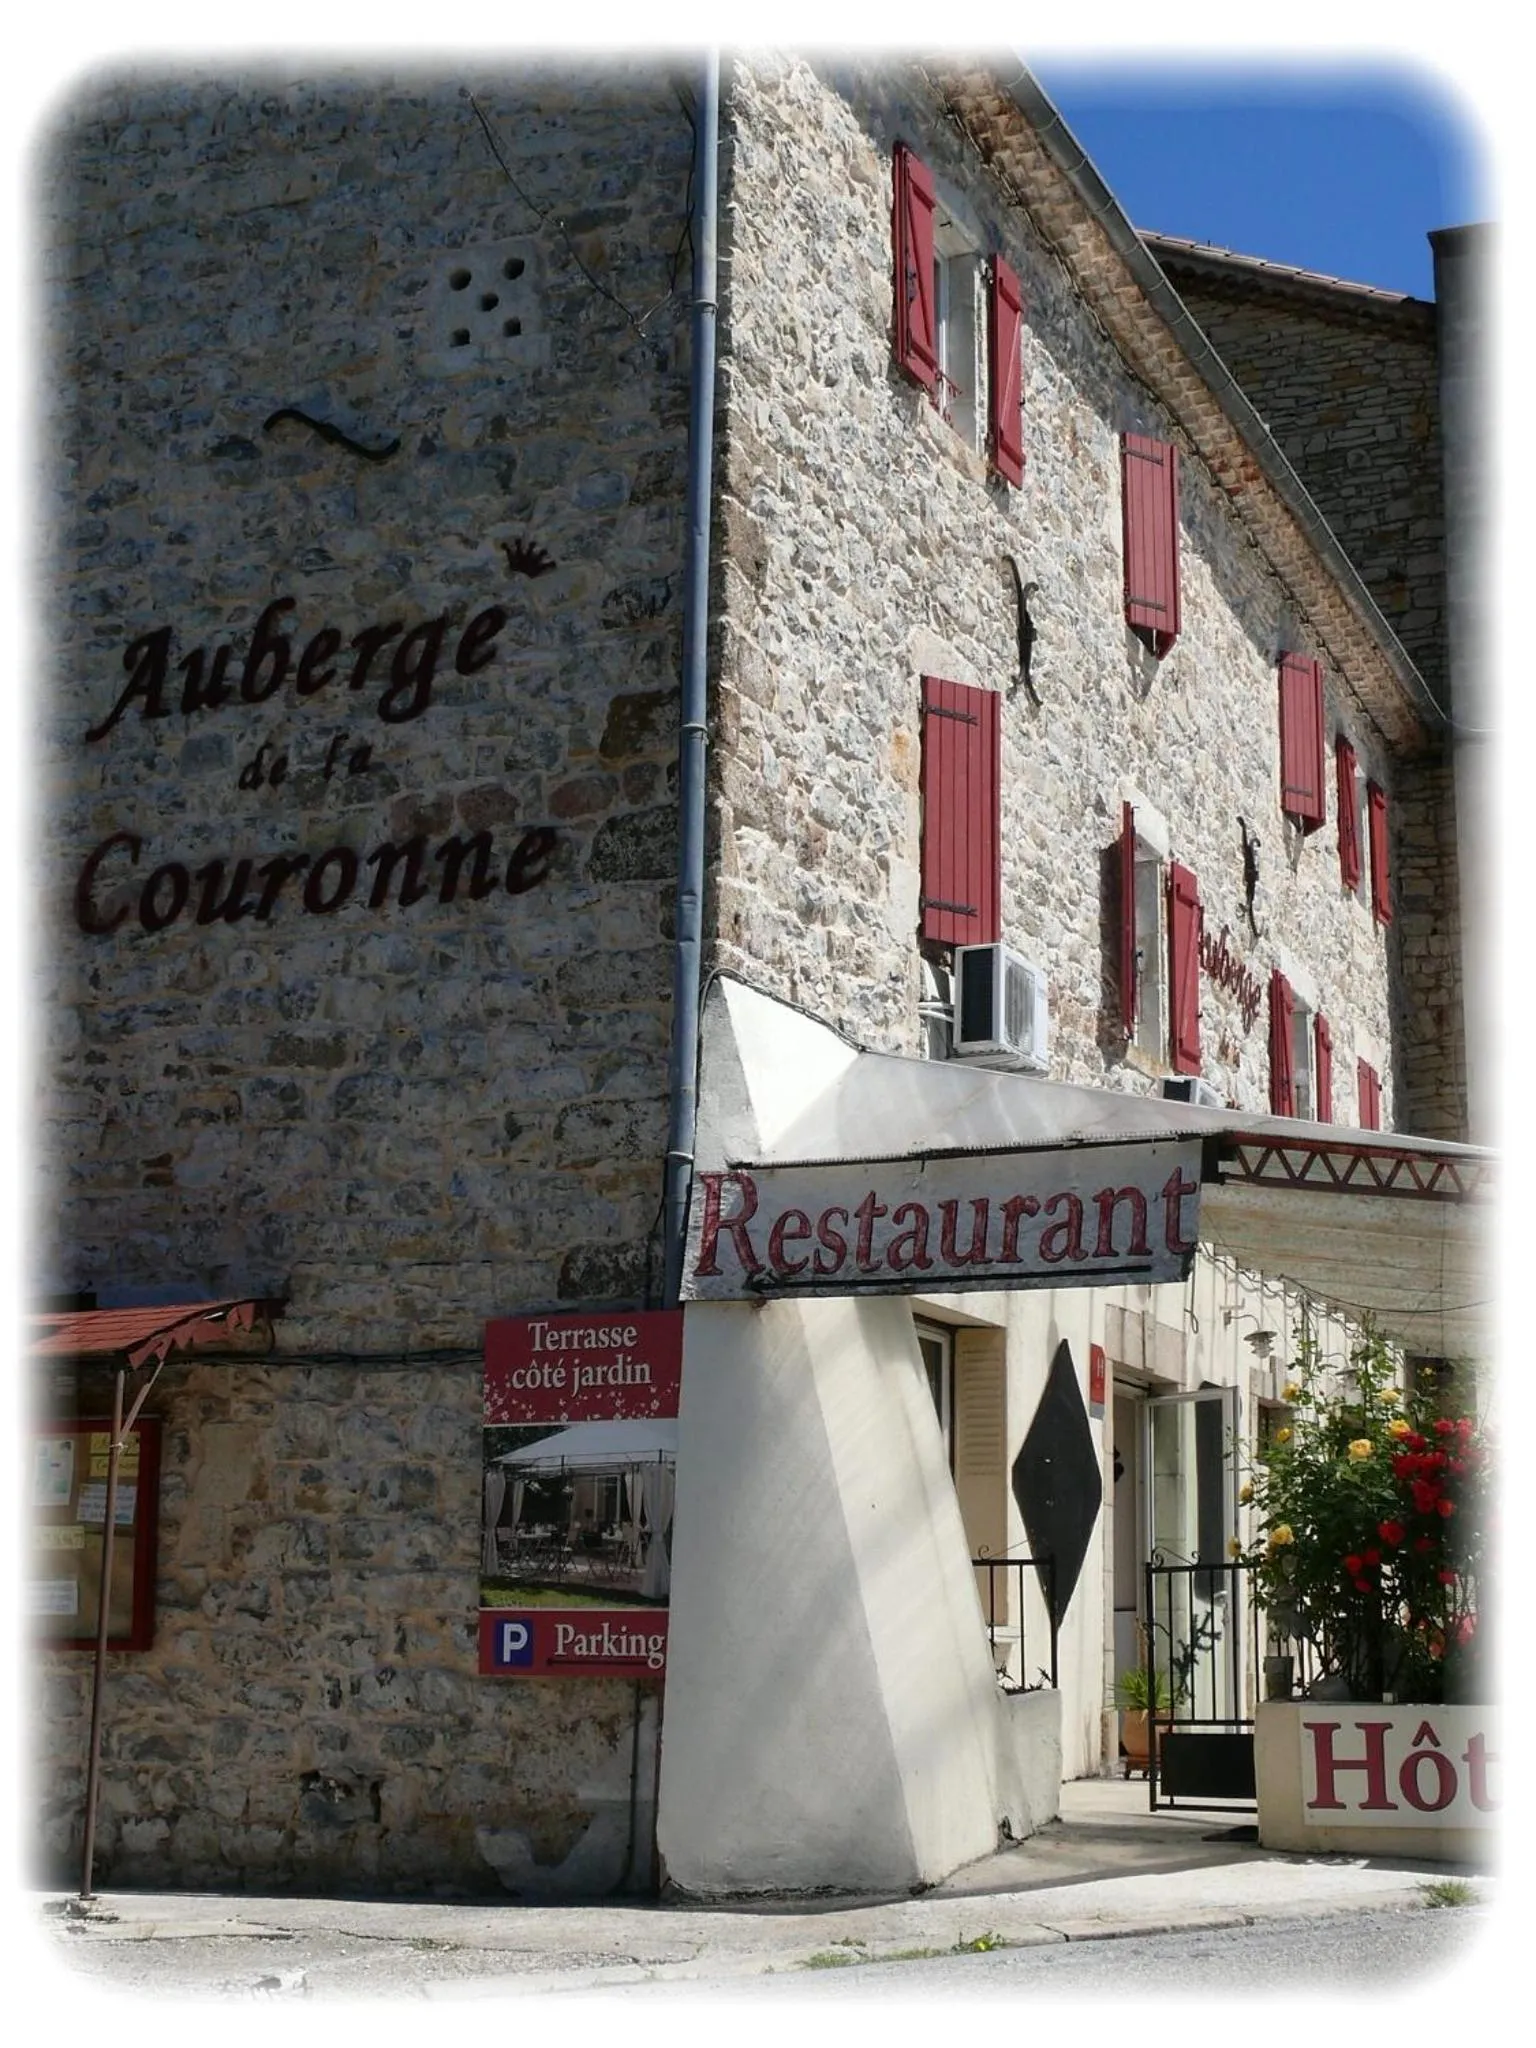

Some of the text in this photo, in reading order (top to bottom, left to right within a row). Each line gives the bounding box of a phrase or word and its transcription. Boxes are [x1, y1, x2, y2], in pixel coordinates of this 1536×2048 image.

[85, 597, 508, 743] Auberge
[238, 732, 373, 791] de la
[74, 827, 557, 935] Couronne
[693, 1165, 1197, 1277] Restaurant
[527, 1321, 638, 1352] Terrasse
[511, 1353, 652, 1398] côté jardin
[502, 1622, 666, 1669] P Parking
